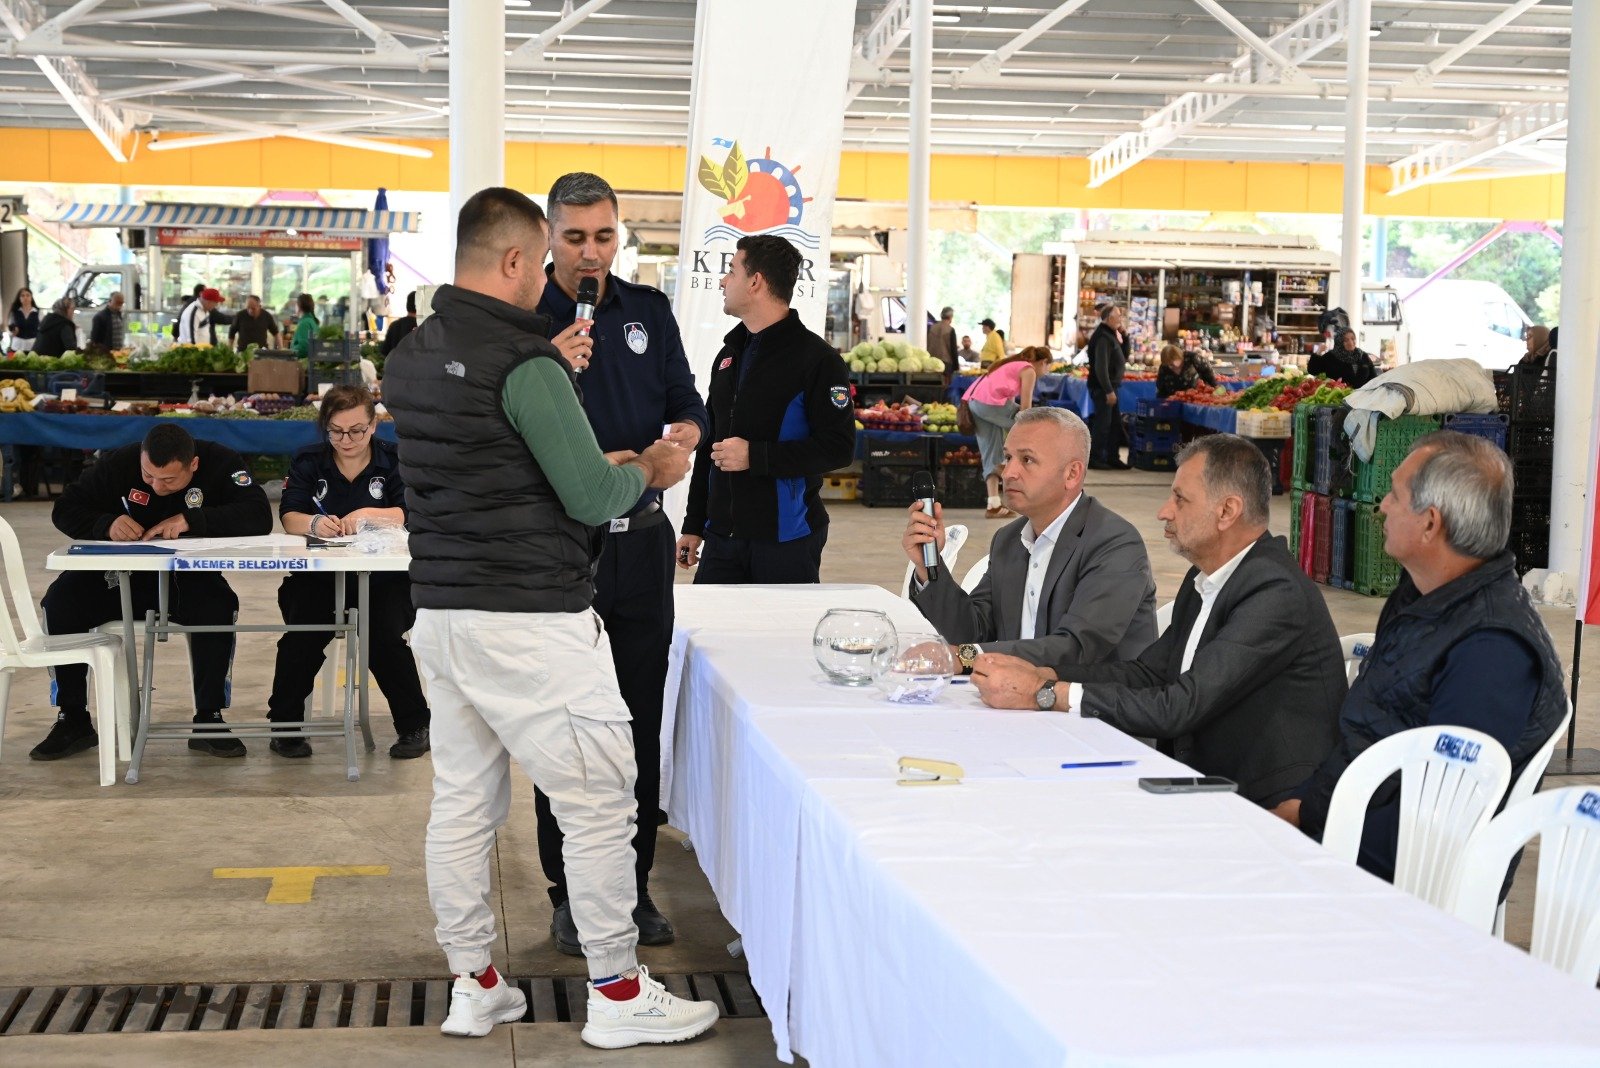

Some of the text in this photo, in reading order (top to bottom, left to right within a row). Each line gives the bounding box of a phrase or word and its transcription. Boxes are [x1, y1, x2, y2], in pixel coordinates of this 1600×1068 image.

[692, 250, 816, 282] KER
[193, 558, 308, 569] KEMER BELEDİYESİ
